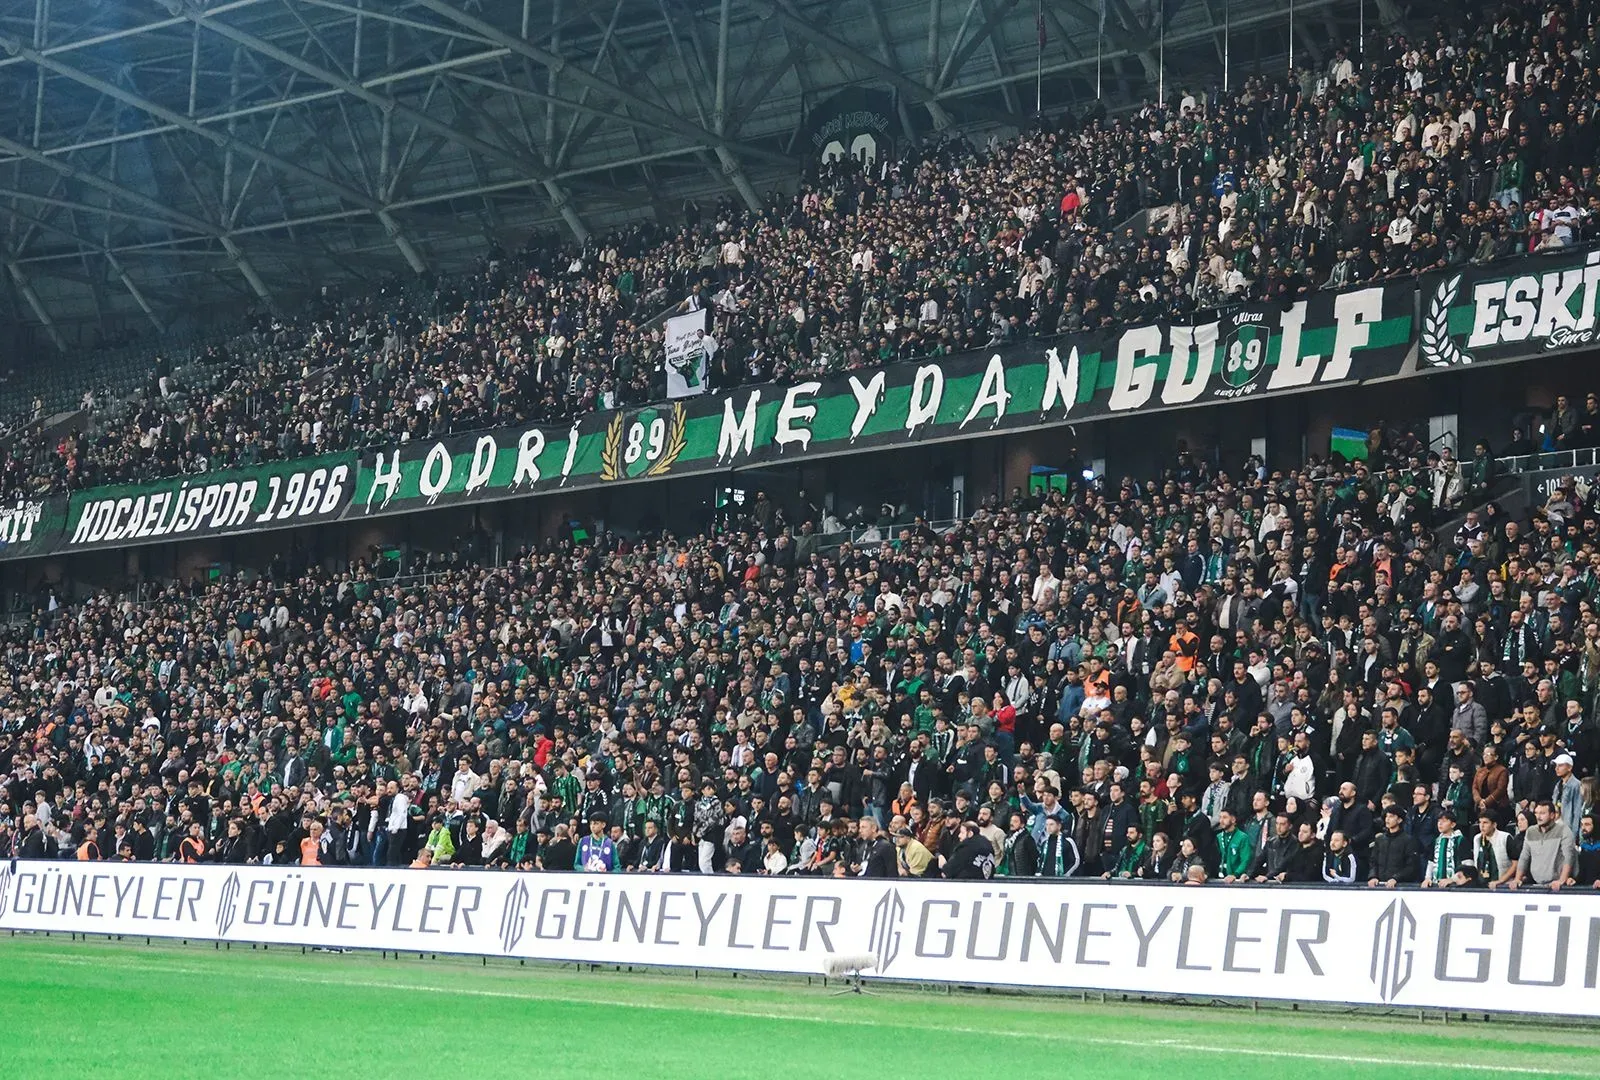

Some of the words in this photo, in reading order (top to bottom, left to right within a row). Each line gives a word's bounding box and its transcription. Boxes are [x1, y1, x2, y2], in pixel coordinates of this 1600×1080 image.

[1232, 312, 1263, 326] Ultras
[1545, 328, 1593, 349] Since
[1227, 339, 1261, 373] 89
[715, 345, 1080, 467] MEYDAN
[365, 419, 583, 515] HODRİ
[624, 417, 665, 465] 89
[70, 481, 258, 545] KOCAELİSPOR
[256, 464, 349, 523] 1966
[13, 867, 204, 922] GÜNEYLER
[243, 873, 483, 936] GÜNEYLER
[535, 881, 842, 953] GÜNEYLER
[914, 891, 1330, 977] GÜNEYLER
